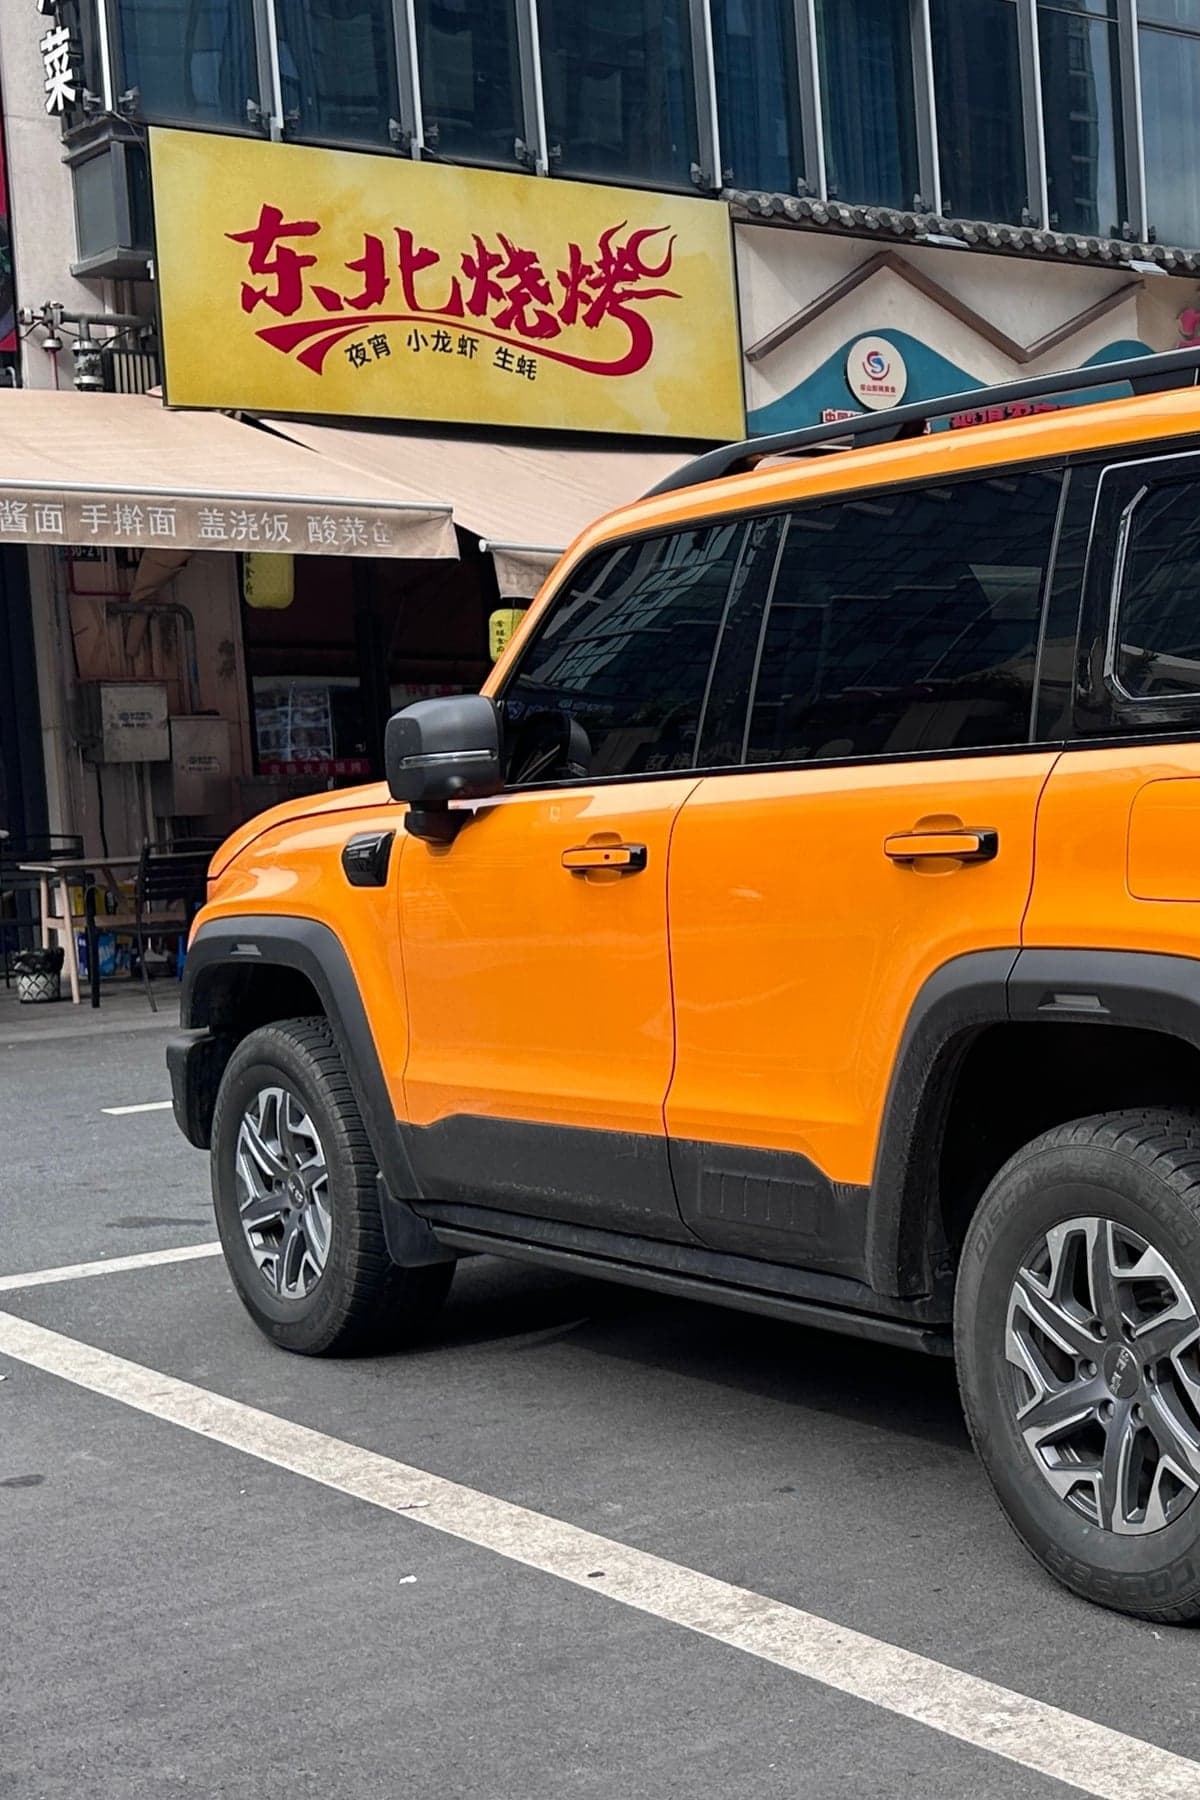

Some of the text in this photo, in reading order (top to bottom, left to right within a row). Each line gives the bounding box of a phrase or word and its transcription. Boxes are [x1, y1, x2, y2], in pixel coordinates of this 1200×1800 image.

[224, 203, 683, 376] 东北烧烤
[345, 328, 539, 381] 夜宵 小龙虾 生蚝
[80, 503, 177, 538] 手擀面
[197, 508, 292, 544] 盖浇饭
